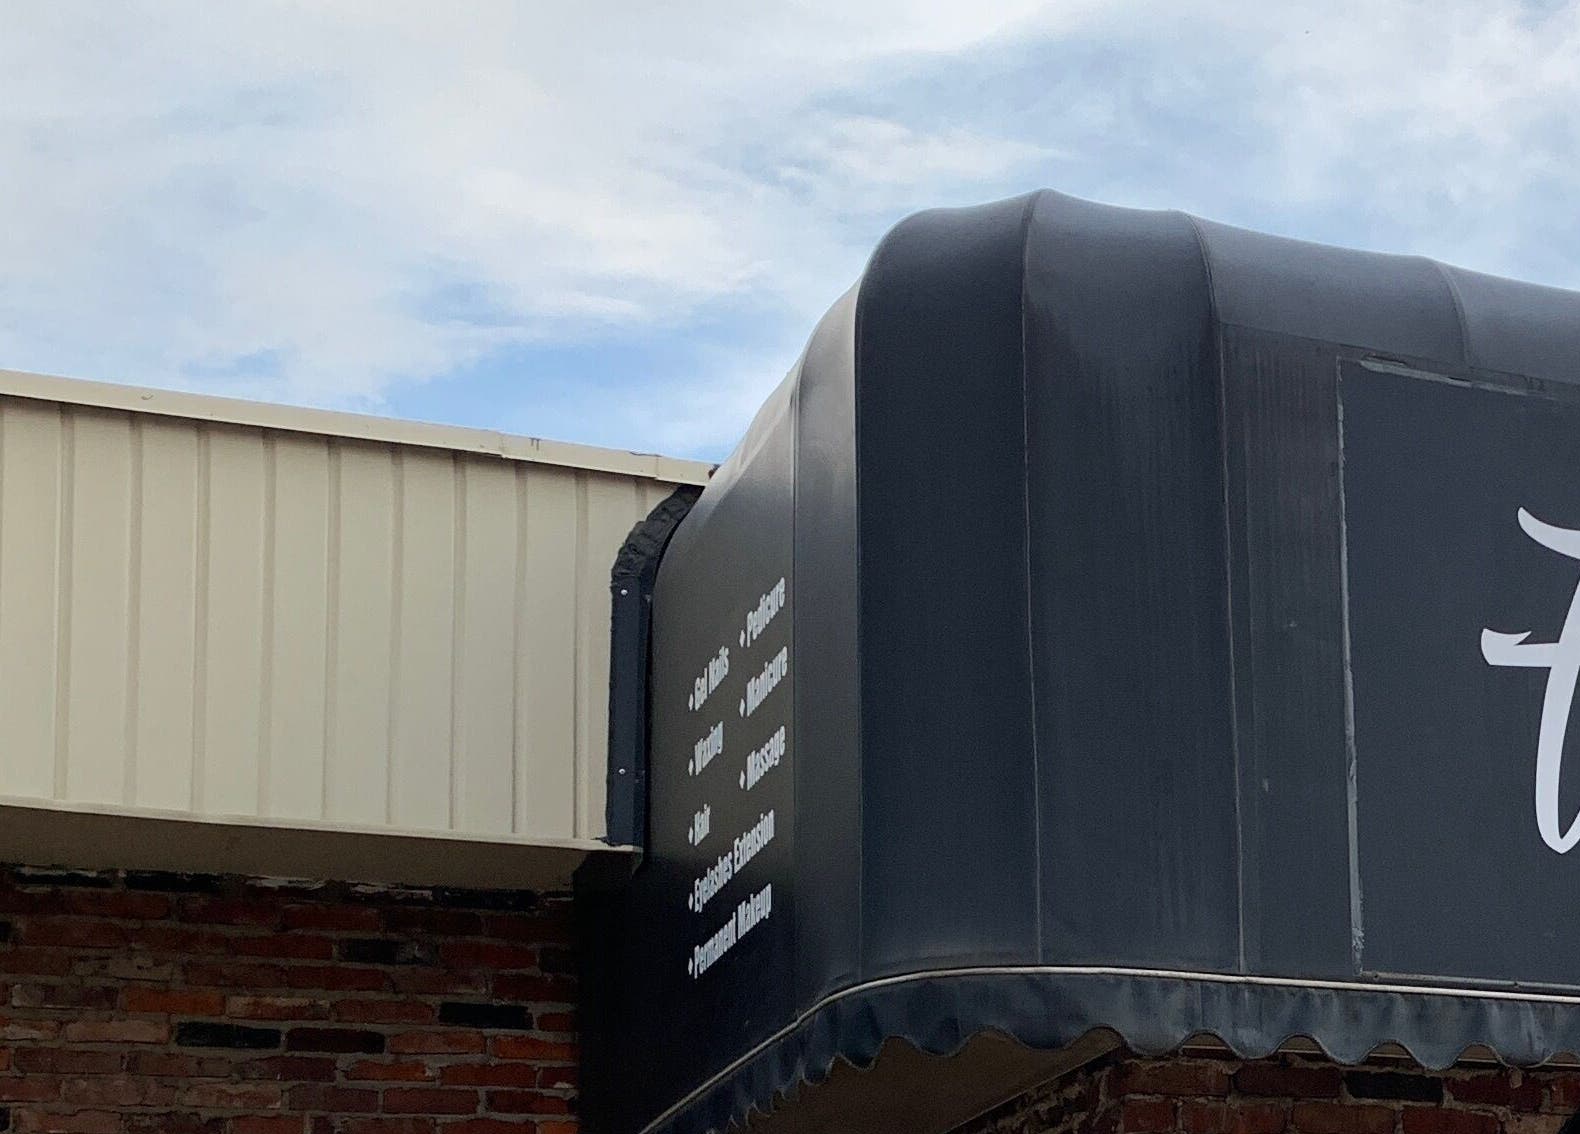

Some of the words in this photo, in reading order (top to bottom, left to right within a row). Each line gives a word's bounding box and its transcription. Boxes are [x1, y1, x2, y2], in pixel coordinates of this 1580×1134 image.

[747, 577, 785, 647] Pedicure
[695, 667, 708, 711] Gel
[709, 646, 729, 694] Nails
[747, 646, 788, 717] Manicure
[695, 721, 723, 775] Waxing
[747, 726, 785, 790] Massage
[695, 804, 710, 846] Hair
[695, 852, 733, 913] Eyelashes
[734, 809, 774, 874] Extension
[695, 912, 736, 979] Permanent
[738, 883, 771, 939] Makeup
